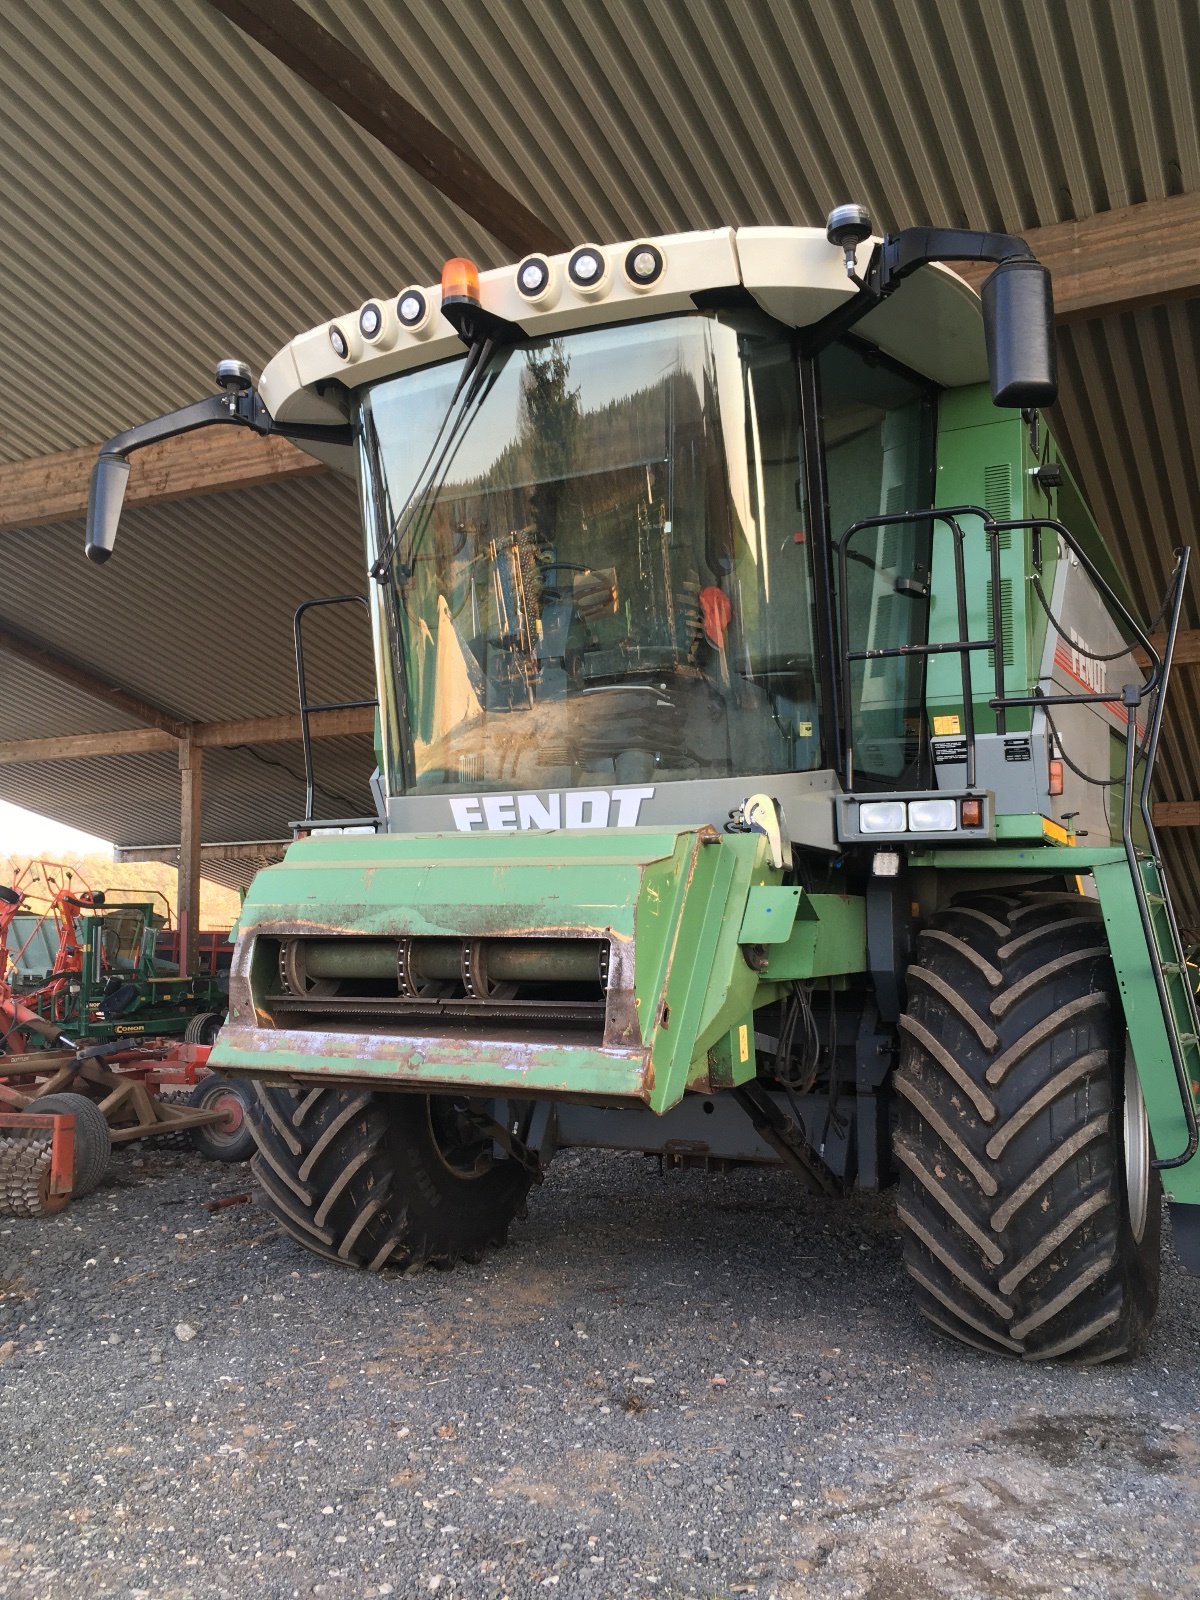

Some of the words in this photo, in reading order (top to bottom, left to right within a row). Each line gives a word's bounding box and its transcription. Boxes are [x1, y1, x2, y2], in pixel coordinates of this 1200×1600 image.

[1071, 627, 1107, 693] FENDT
[449, 787, 656, 832] FENDT
[116, 1025, 145, 1034] CONOR
